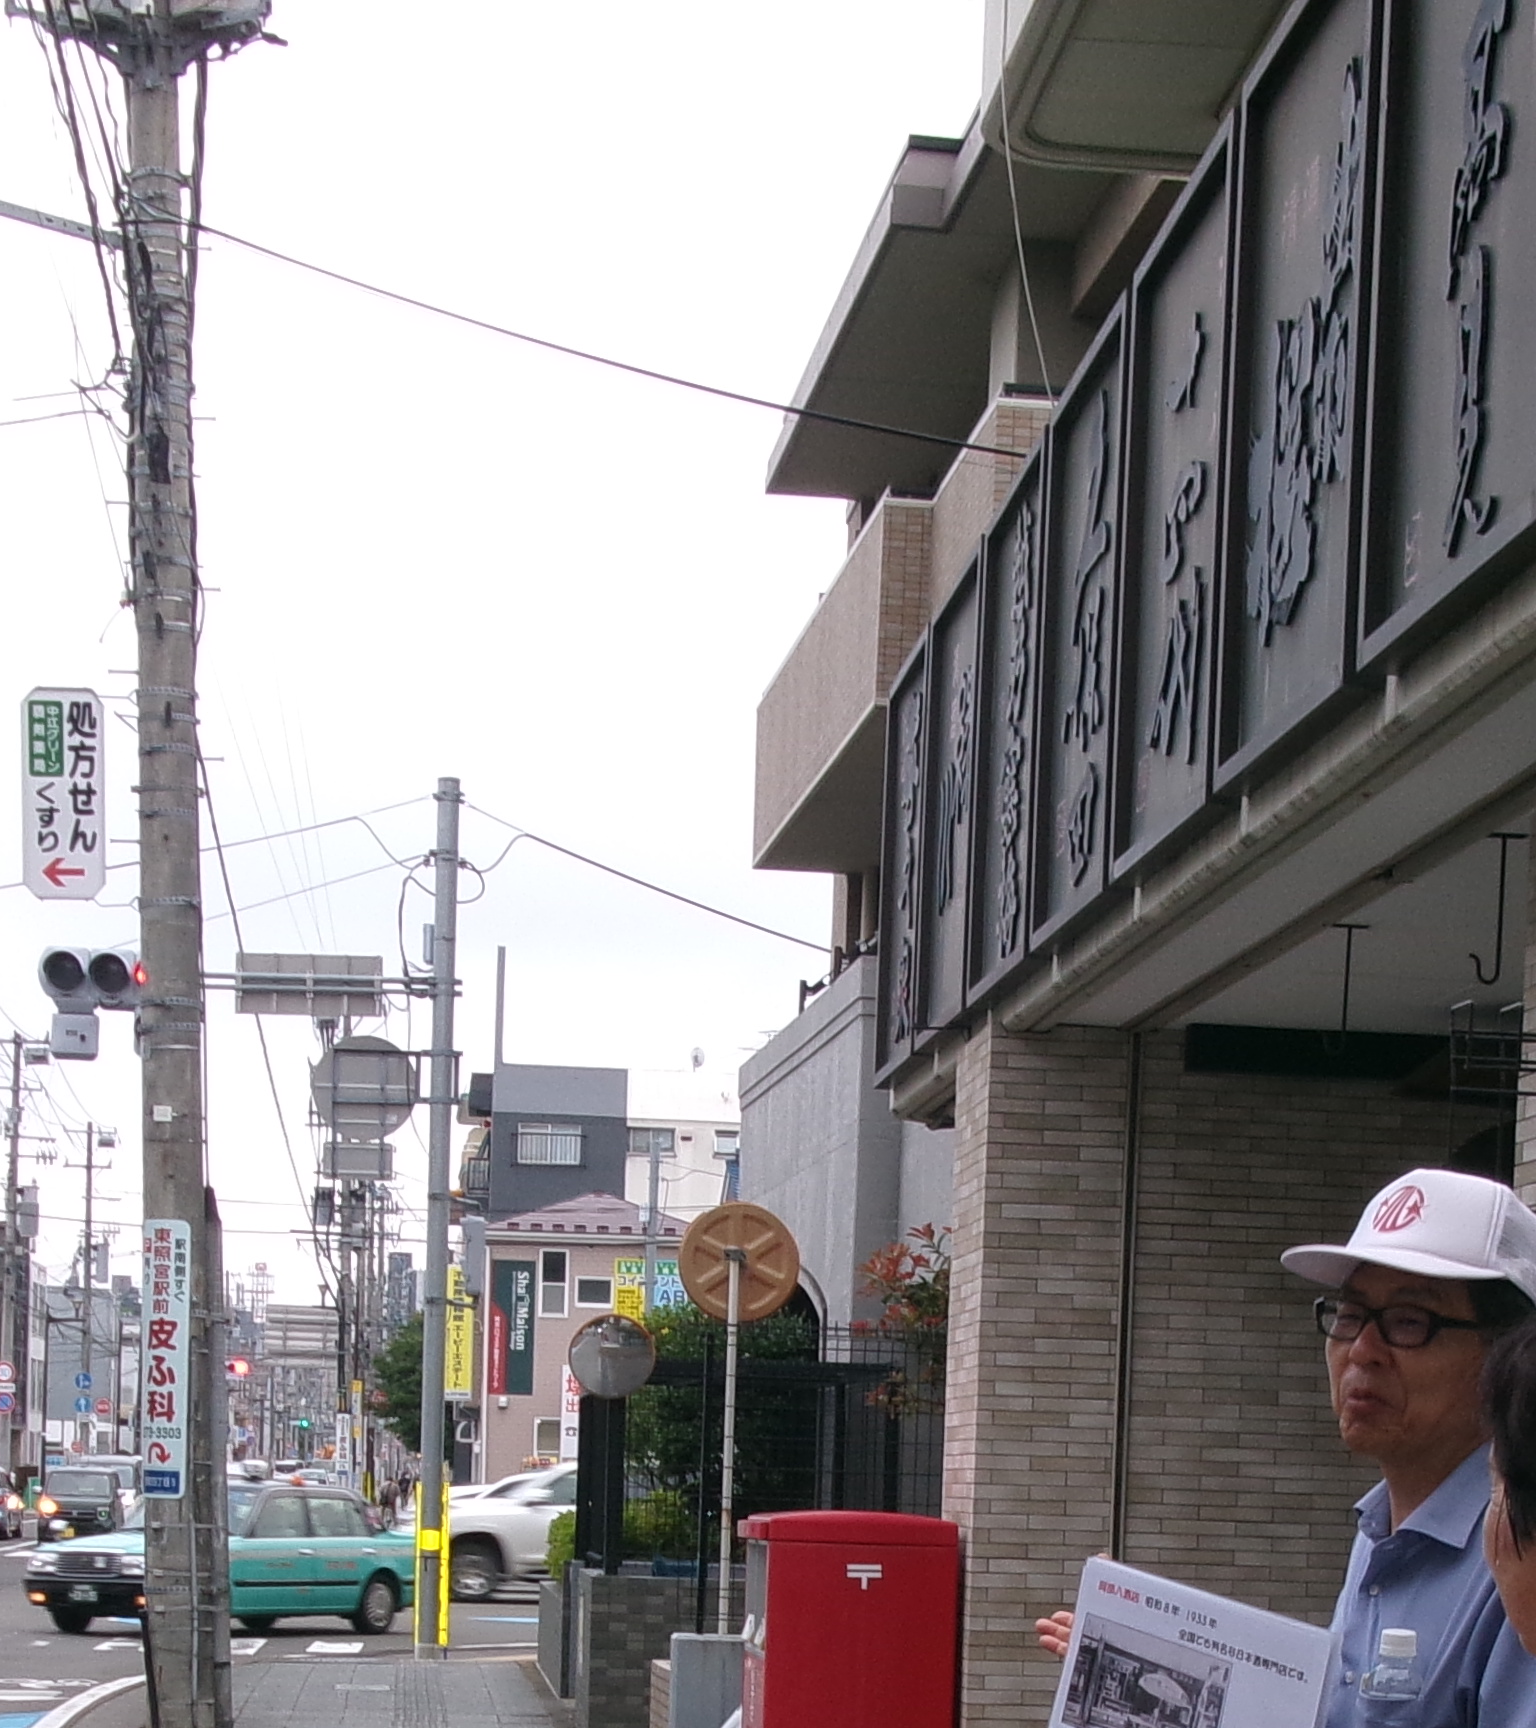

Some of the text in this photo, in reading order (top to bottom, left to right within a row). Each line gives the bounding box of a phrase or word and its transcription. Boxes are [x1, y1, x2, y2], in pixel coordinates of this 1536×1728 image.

[36, 782, 61, 852] くすり
[66, 701, 97, 853] 処方せん
[147, 1317, 178, 1423] 皮ふ科
